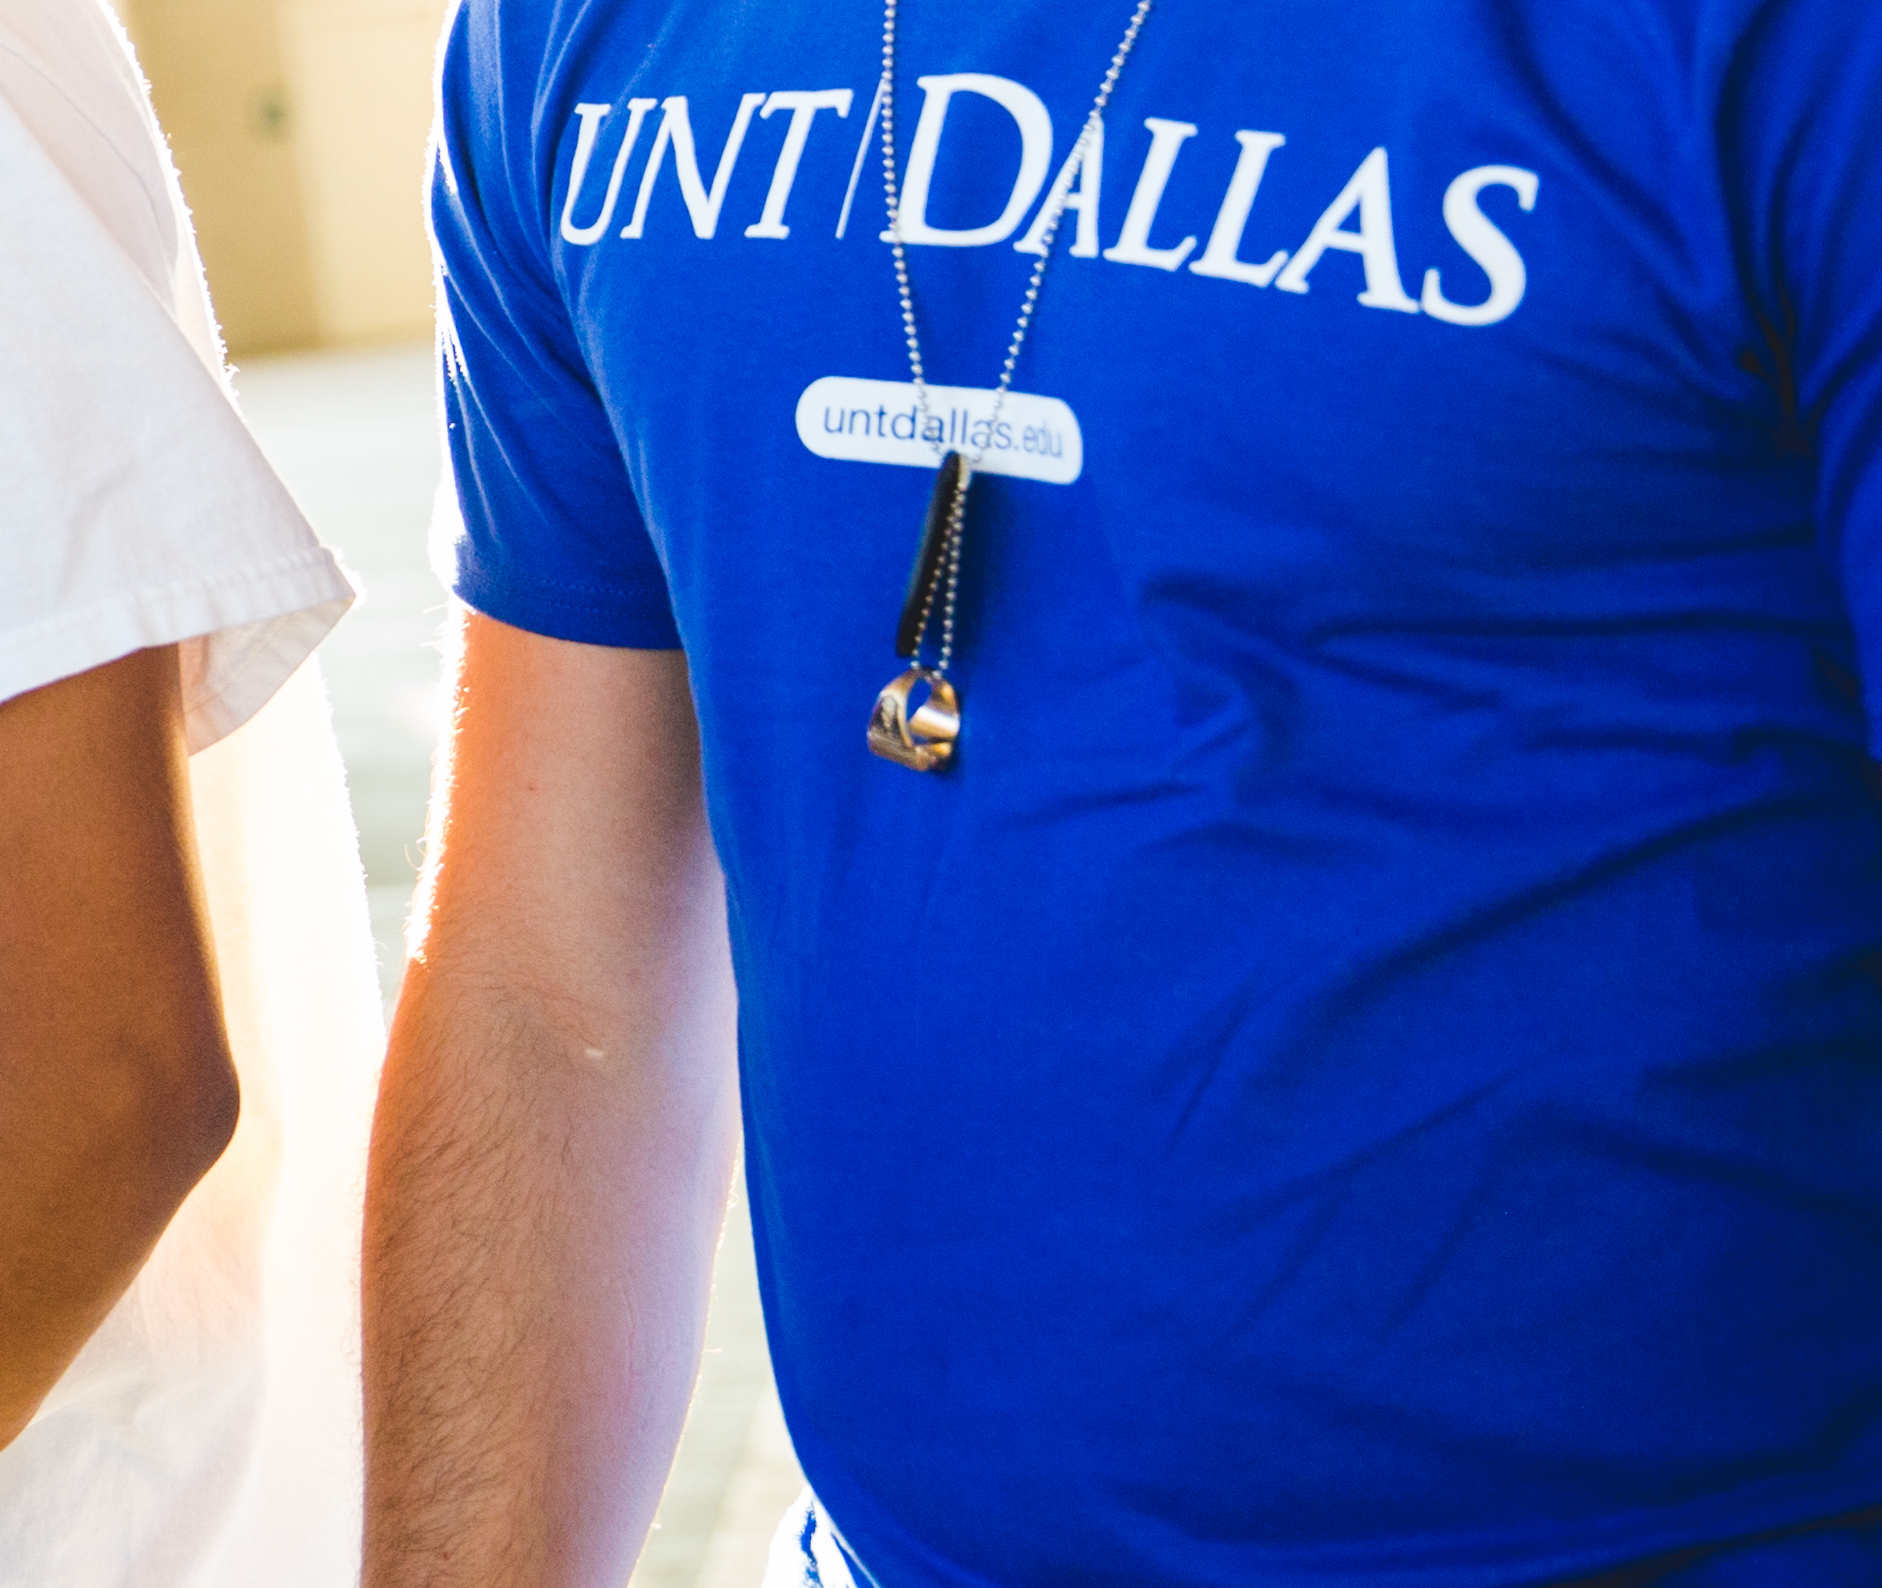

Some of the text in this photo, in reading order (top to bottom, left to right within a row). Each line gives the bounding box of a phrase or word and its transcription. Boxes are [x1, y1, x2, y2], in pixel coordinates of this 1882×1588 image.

[559, 72, 1539, 326] UNT DALLAS
[823, 403, 1064, 459] untdallas.edu
